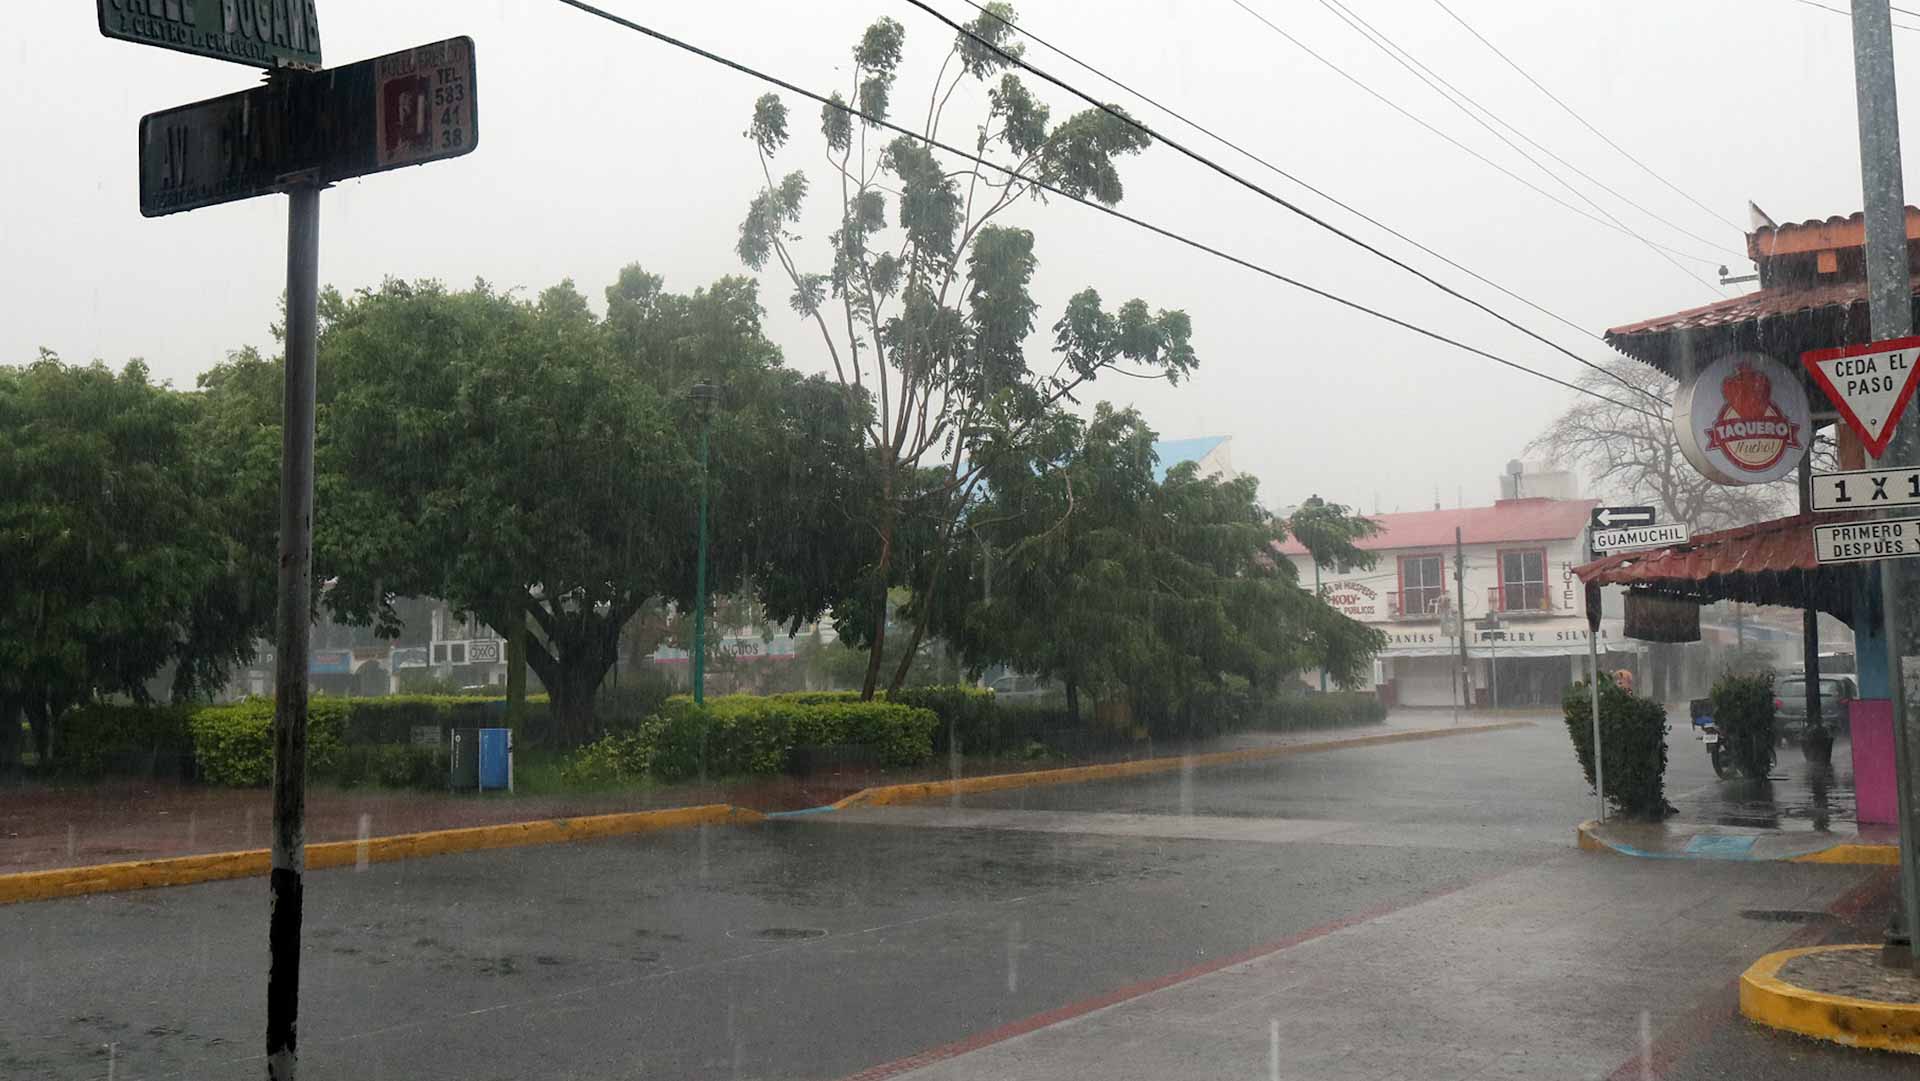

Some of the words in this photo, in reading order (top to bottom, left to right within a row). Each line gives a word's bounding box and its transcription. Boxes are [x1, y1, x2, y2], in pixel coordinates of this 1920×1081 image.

[435, 84, 465, 105] 583
[441, 105, 461, 126] 41
[442, 127, 462, 149] 38
[1835, 357, 1877, 378] CEDA
[1889, 353, 1908, 371] EL
[1847, 375, 1893, 396] PASO
[1716, 421, 1788, 439] TAQUERO
[1834, 480, 1852, 503] 1
[1871, 477, 1889, 501] X
[1908, 474, 1920, 498] 1
[1597, 528, 1685, 547] GUAMUCHIL
[1832, 524, 1903, 542] PRIMERO
[1834, 540, 1904, 558] DESPUES
[1562, 561, 1574, 610] HOTEL
[1556, 630, 1608, 641] SILVR
[470, 645, 496, 659] OXXO
